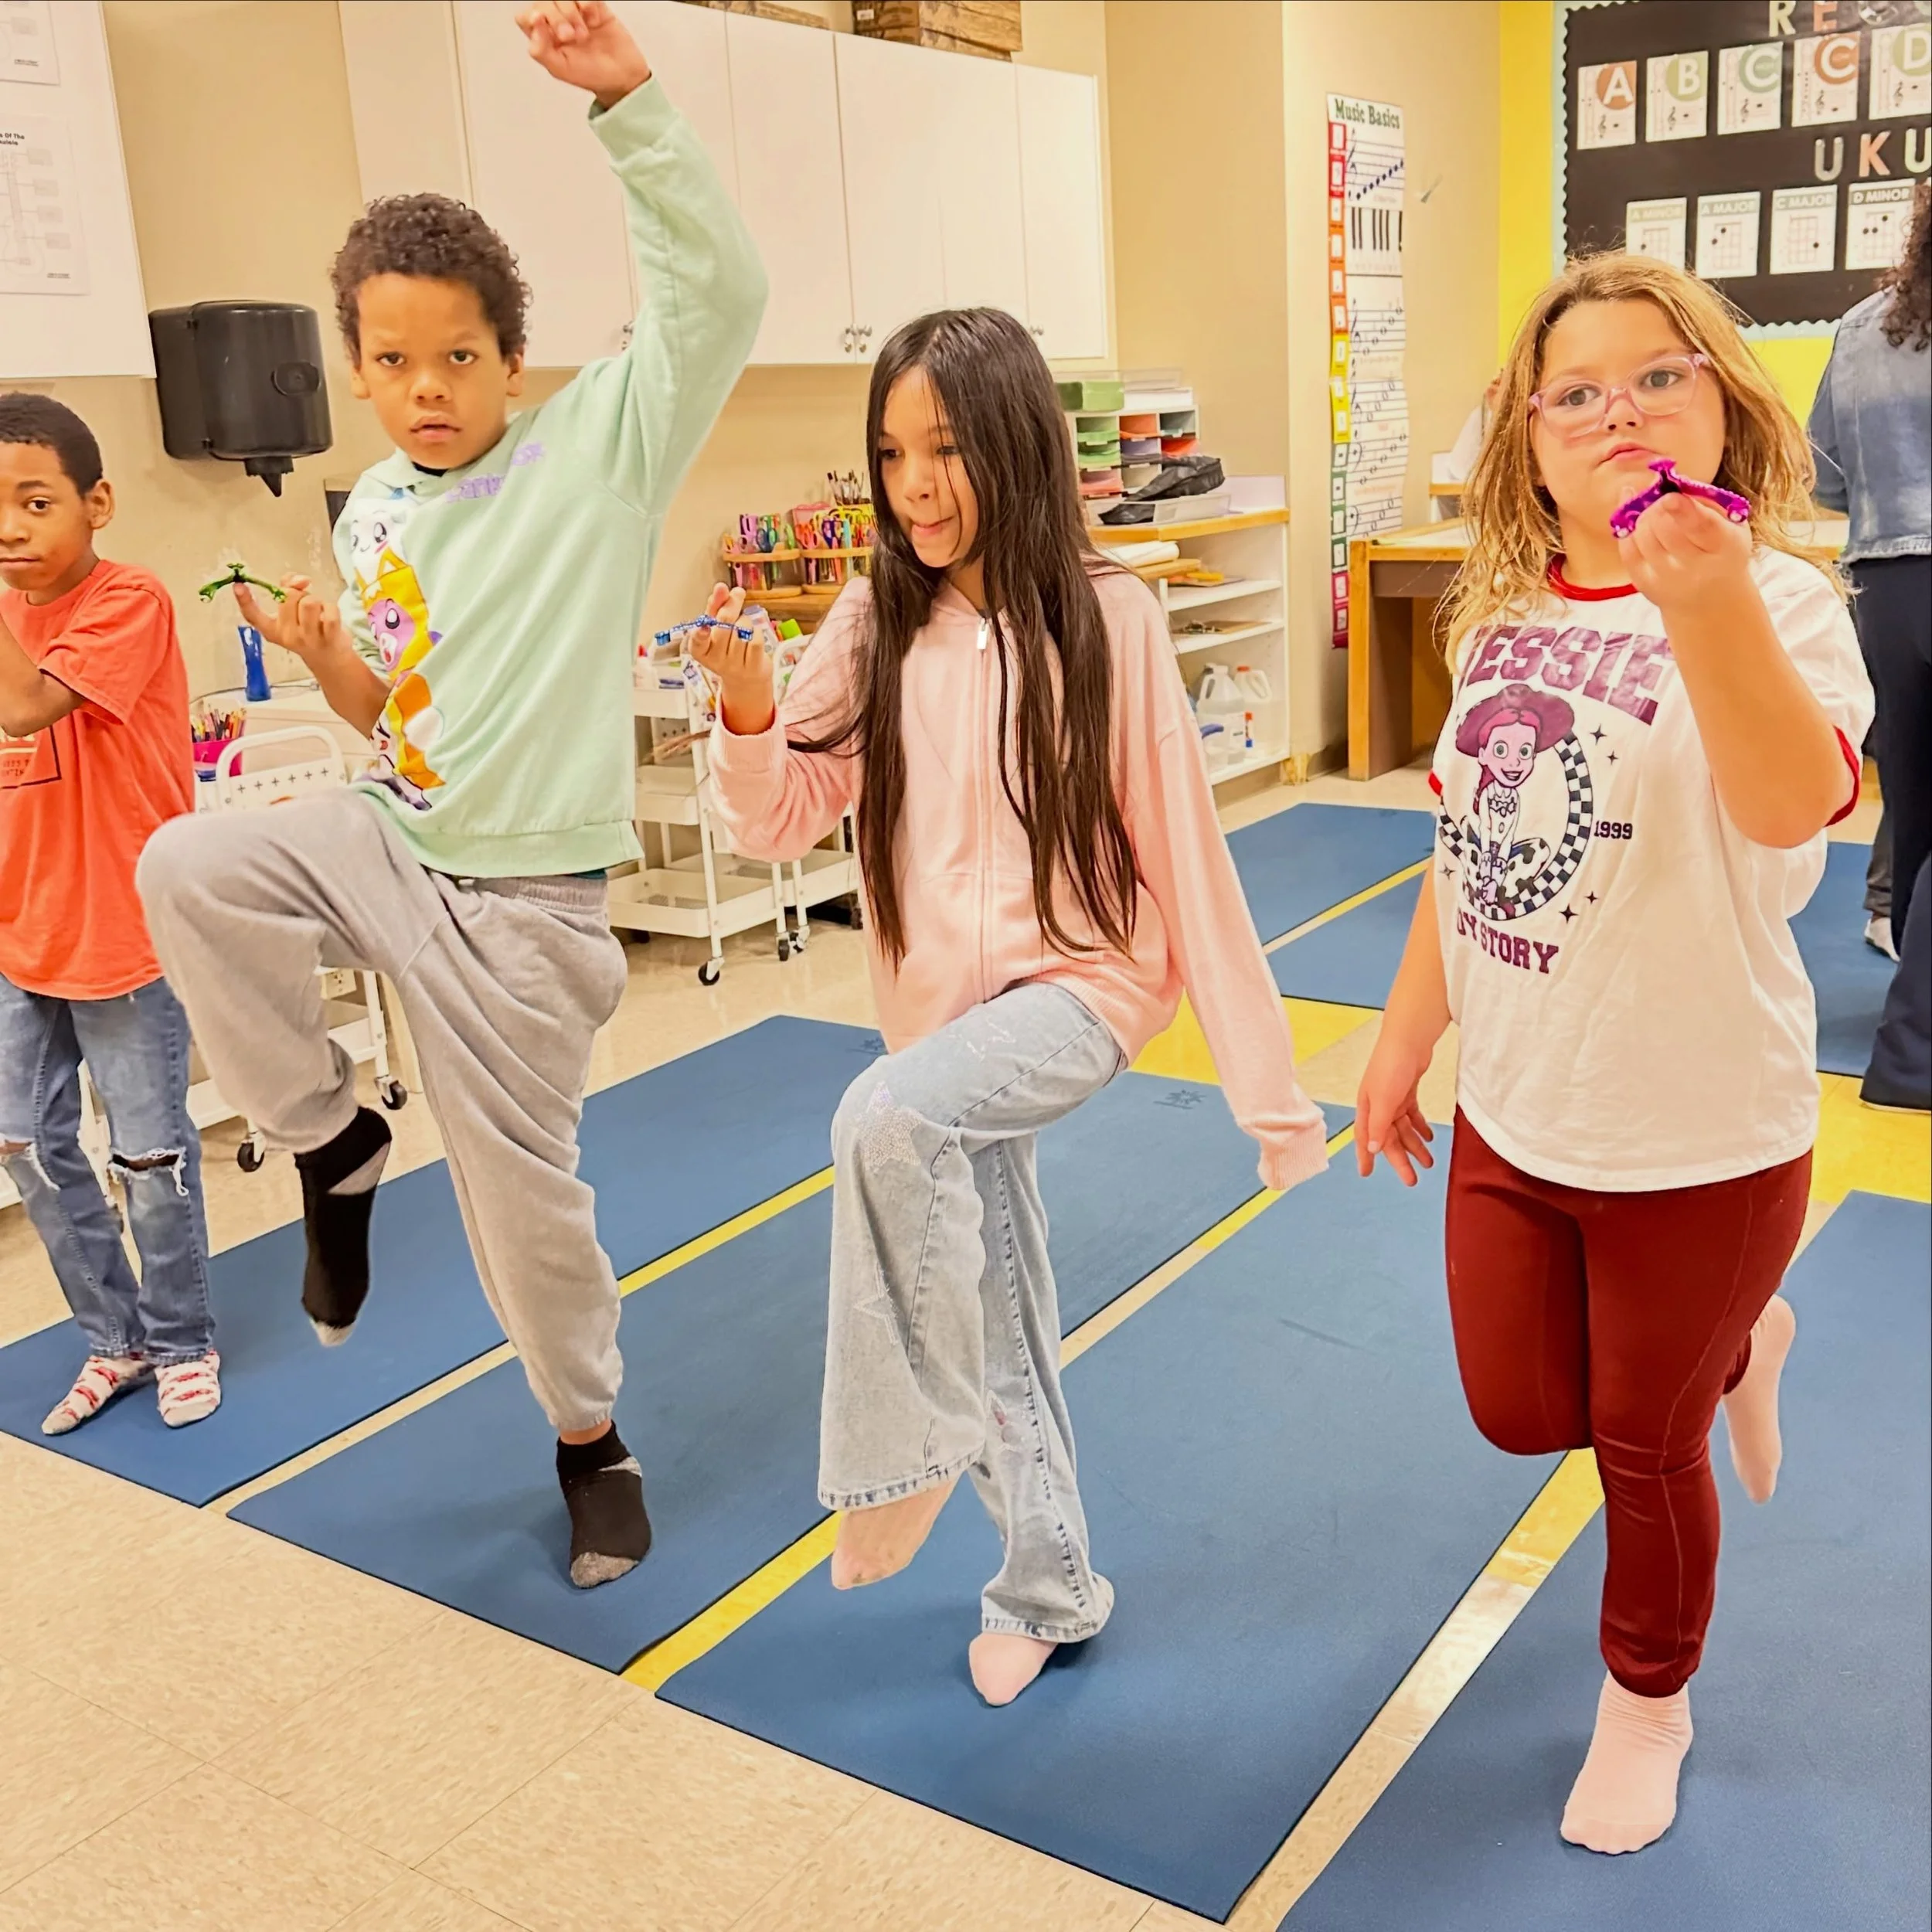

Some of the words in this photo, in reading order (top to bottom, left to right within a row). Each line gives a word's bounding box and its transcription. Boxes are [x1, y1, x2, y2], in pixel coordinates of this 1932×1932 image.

[1745, 47, 1780, 87] C
[1821, 38, 1856, 78] C
[1903, 29, 1930, 70] D
[1603, 66, 1634, 105] A
[1678, 58, 1700, 95] B
[1335, 98, 1366, 124] Music
[1368, 104, 1400, 130] Basics
[1701, 204, 1710, 215] A
[1712, 200, 1756, 213] MAJOR
[1777, 197, 1787, 209] C
[1787, 194, 1832, 206] MAJOR
[1854, 192, 1865, 204] D
[1866, 189, 1911, 202] MINOR
[1594, 820, 1633, 840] 1999
[1480, 920, 1560, 975] STORY
